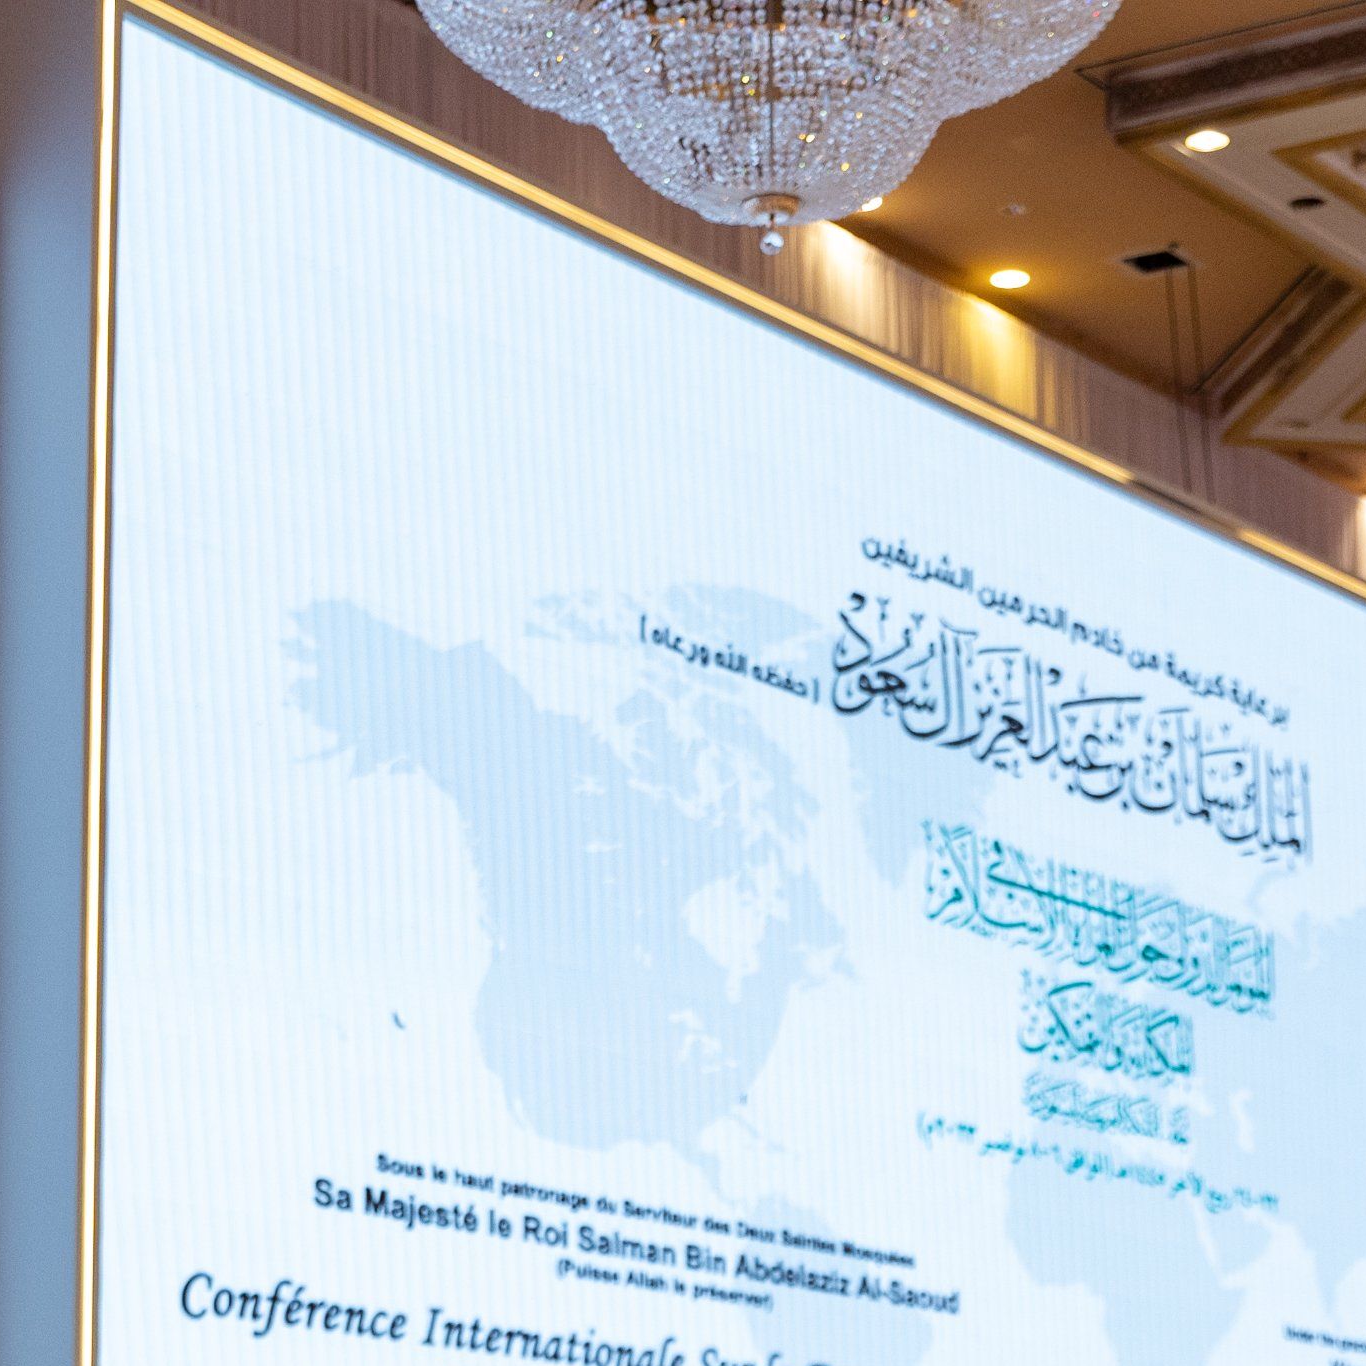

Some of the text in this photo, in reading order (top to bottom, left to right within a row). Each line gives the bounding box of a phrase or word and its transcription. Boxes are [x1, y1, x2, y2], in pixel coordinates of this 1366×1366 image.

[861, 538, 975, 593] الشريفين
[978, 587, 1068, 634] الحرمين
[1069, 621, 1124, 657] خادم
[1128, 649, 1161, 671] من
[376, 1153, 425, 1180] Sous
[431, 1164, 447, 1183] le
[454, 1169, 494, 1192] haut
[501, 1180, 590, 1211] patronage
[314, 1178, 960, 1315] Sa Majesté le Roi Salman Bin Abdelaziz Al-Saoud
[180, 1272, 408, 1340] Conférence
[627, 1270, 668, 1291] Allah
